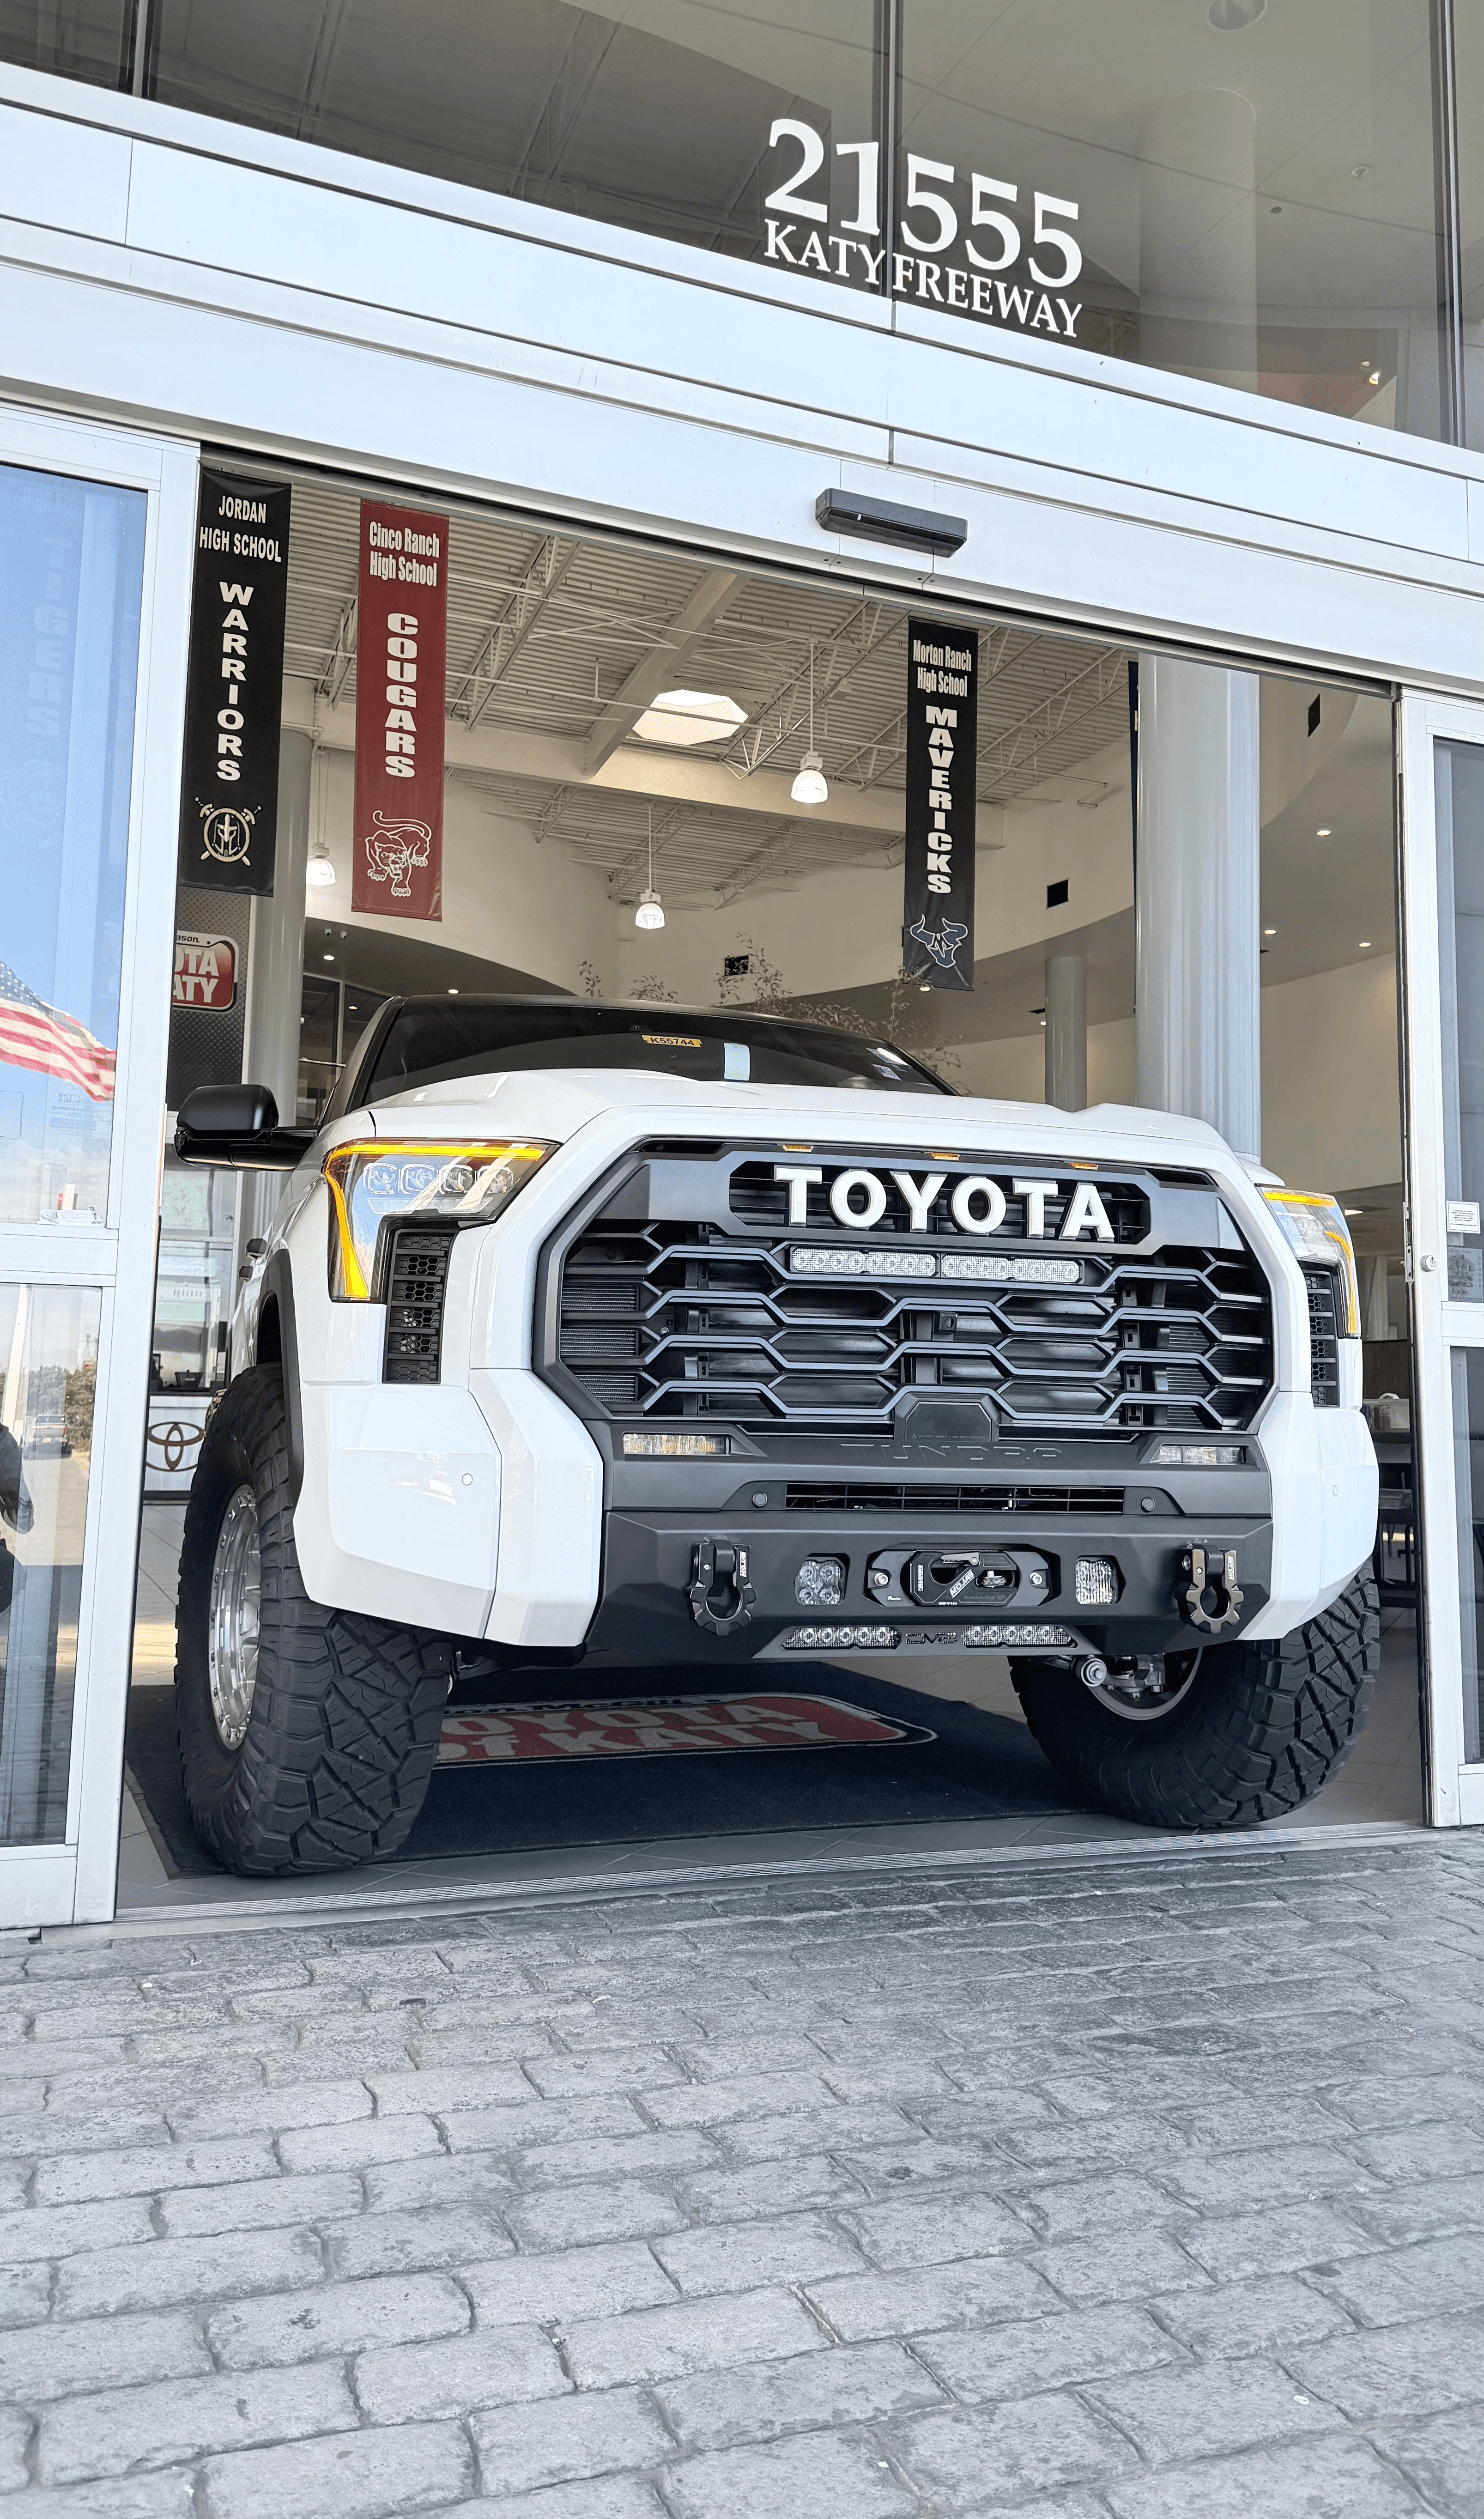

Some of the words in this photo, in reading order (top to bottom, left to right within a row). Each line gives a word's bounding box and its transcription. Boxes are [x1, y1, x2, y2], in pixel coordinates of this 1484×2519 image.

[765, 118, 1082, 287] 21555
[763, 219, 886, 285] KATY
[892, 253, 1082, 338] FREEWAY
[218, 495, 267, 524] JORDAN
[199, 527, 230, 552] HIGH
[233, 533, 281, 563] SCHOOL
[369, 521, 402, 551] Cinco
[404, 528, 440, 558] Ranch
[369, 551, 396, 581] High
[398, 556, 437, 587] School
[913, 639, 944, 667] Morton
[945, 645, 972, 672] Ranch
[216, 581, 254, 781] WARRIORS
[384, 613, 418, 778] COUGARS
[917, 667, 937, 693] High
[938, 670, 968, 698] School
[926, 704, 957, 894] MAVERICKS
[774, 1165, 1115, 1242] TOYOTA
[841, 1443, 1064, 1464] TUNDRA
[538, 1722, 837, 1753] KATY
